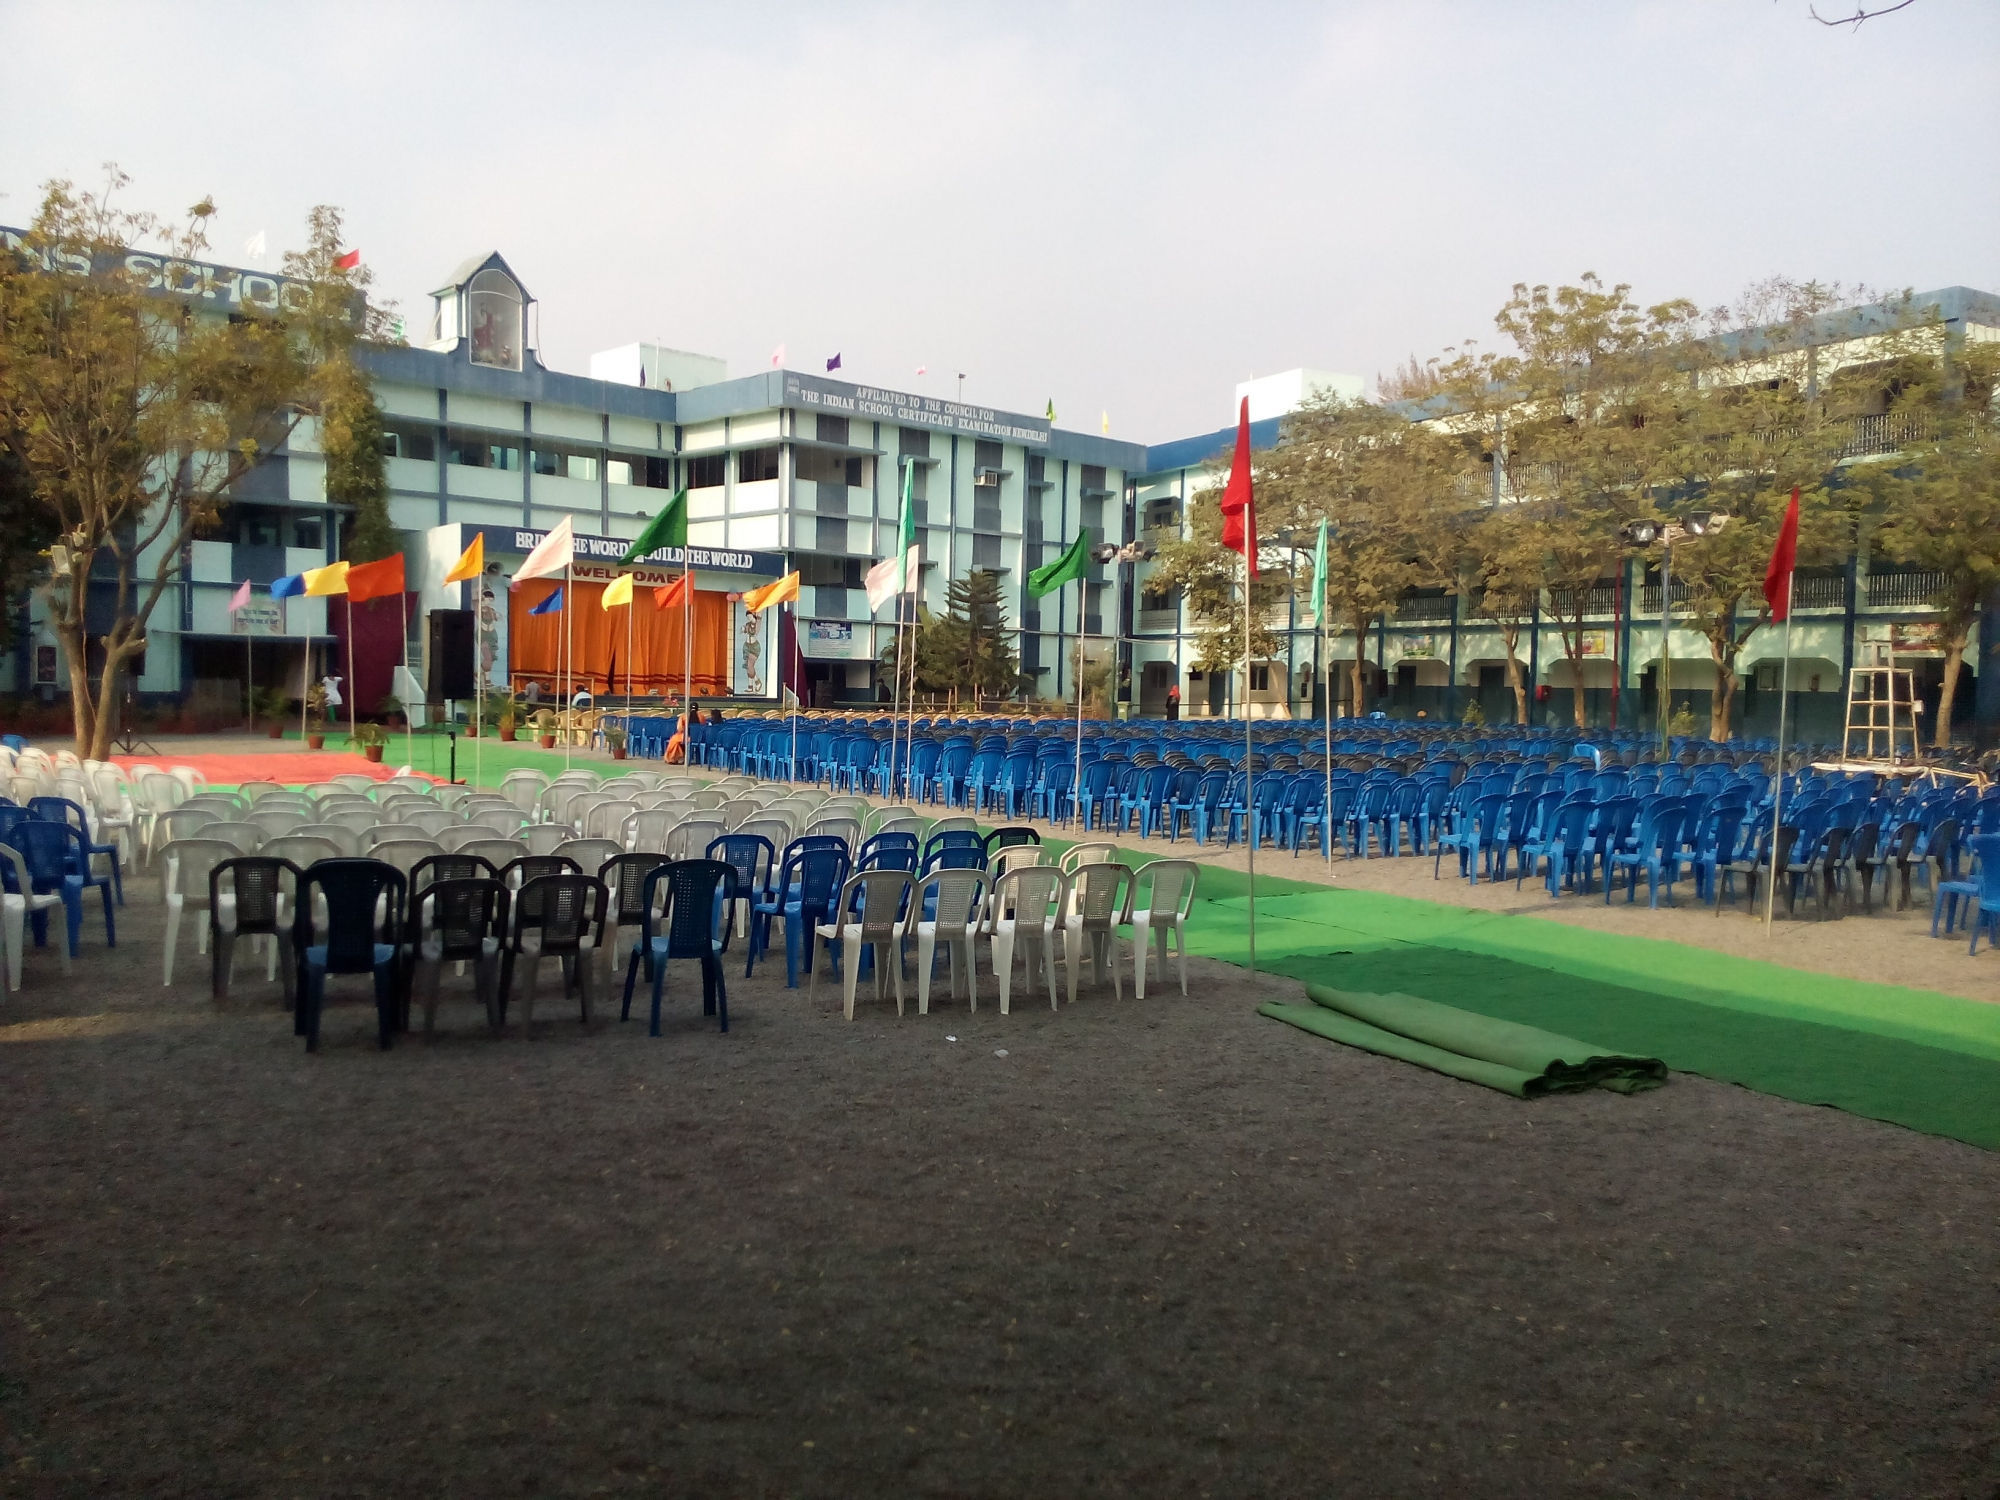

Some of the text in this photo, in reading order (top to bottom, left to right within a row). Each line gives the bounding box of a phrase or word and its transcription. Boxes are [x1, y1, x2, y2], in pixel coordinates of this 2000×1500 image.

[125, 254, 351, 321] SCHOO
[801, 389, 819, 403] THE
[822, 393, 855, 410] INDIAN
[858, 401, 894, 417] SCHOOL
[897, 407, 954, 427] CERTIFICATE
[958, 417, 1011, 437] EXAMINATION
[856, 386, 995, 422] AFFILIATED TO THE COUNCIL FOR
[572, 537, 588, 554] HE
[588, 540, 629, 557] WORD
[688, 549, 711, 565] THE
[711, 552, 753, 569] WORLD
